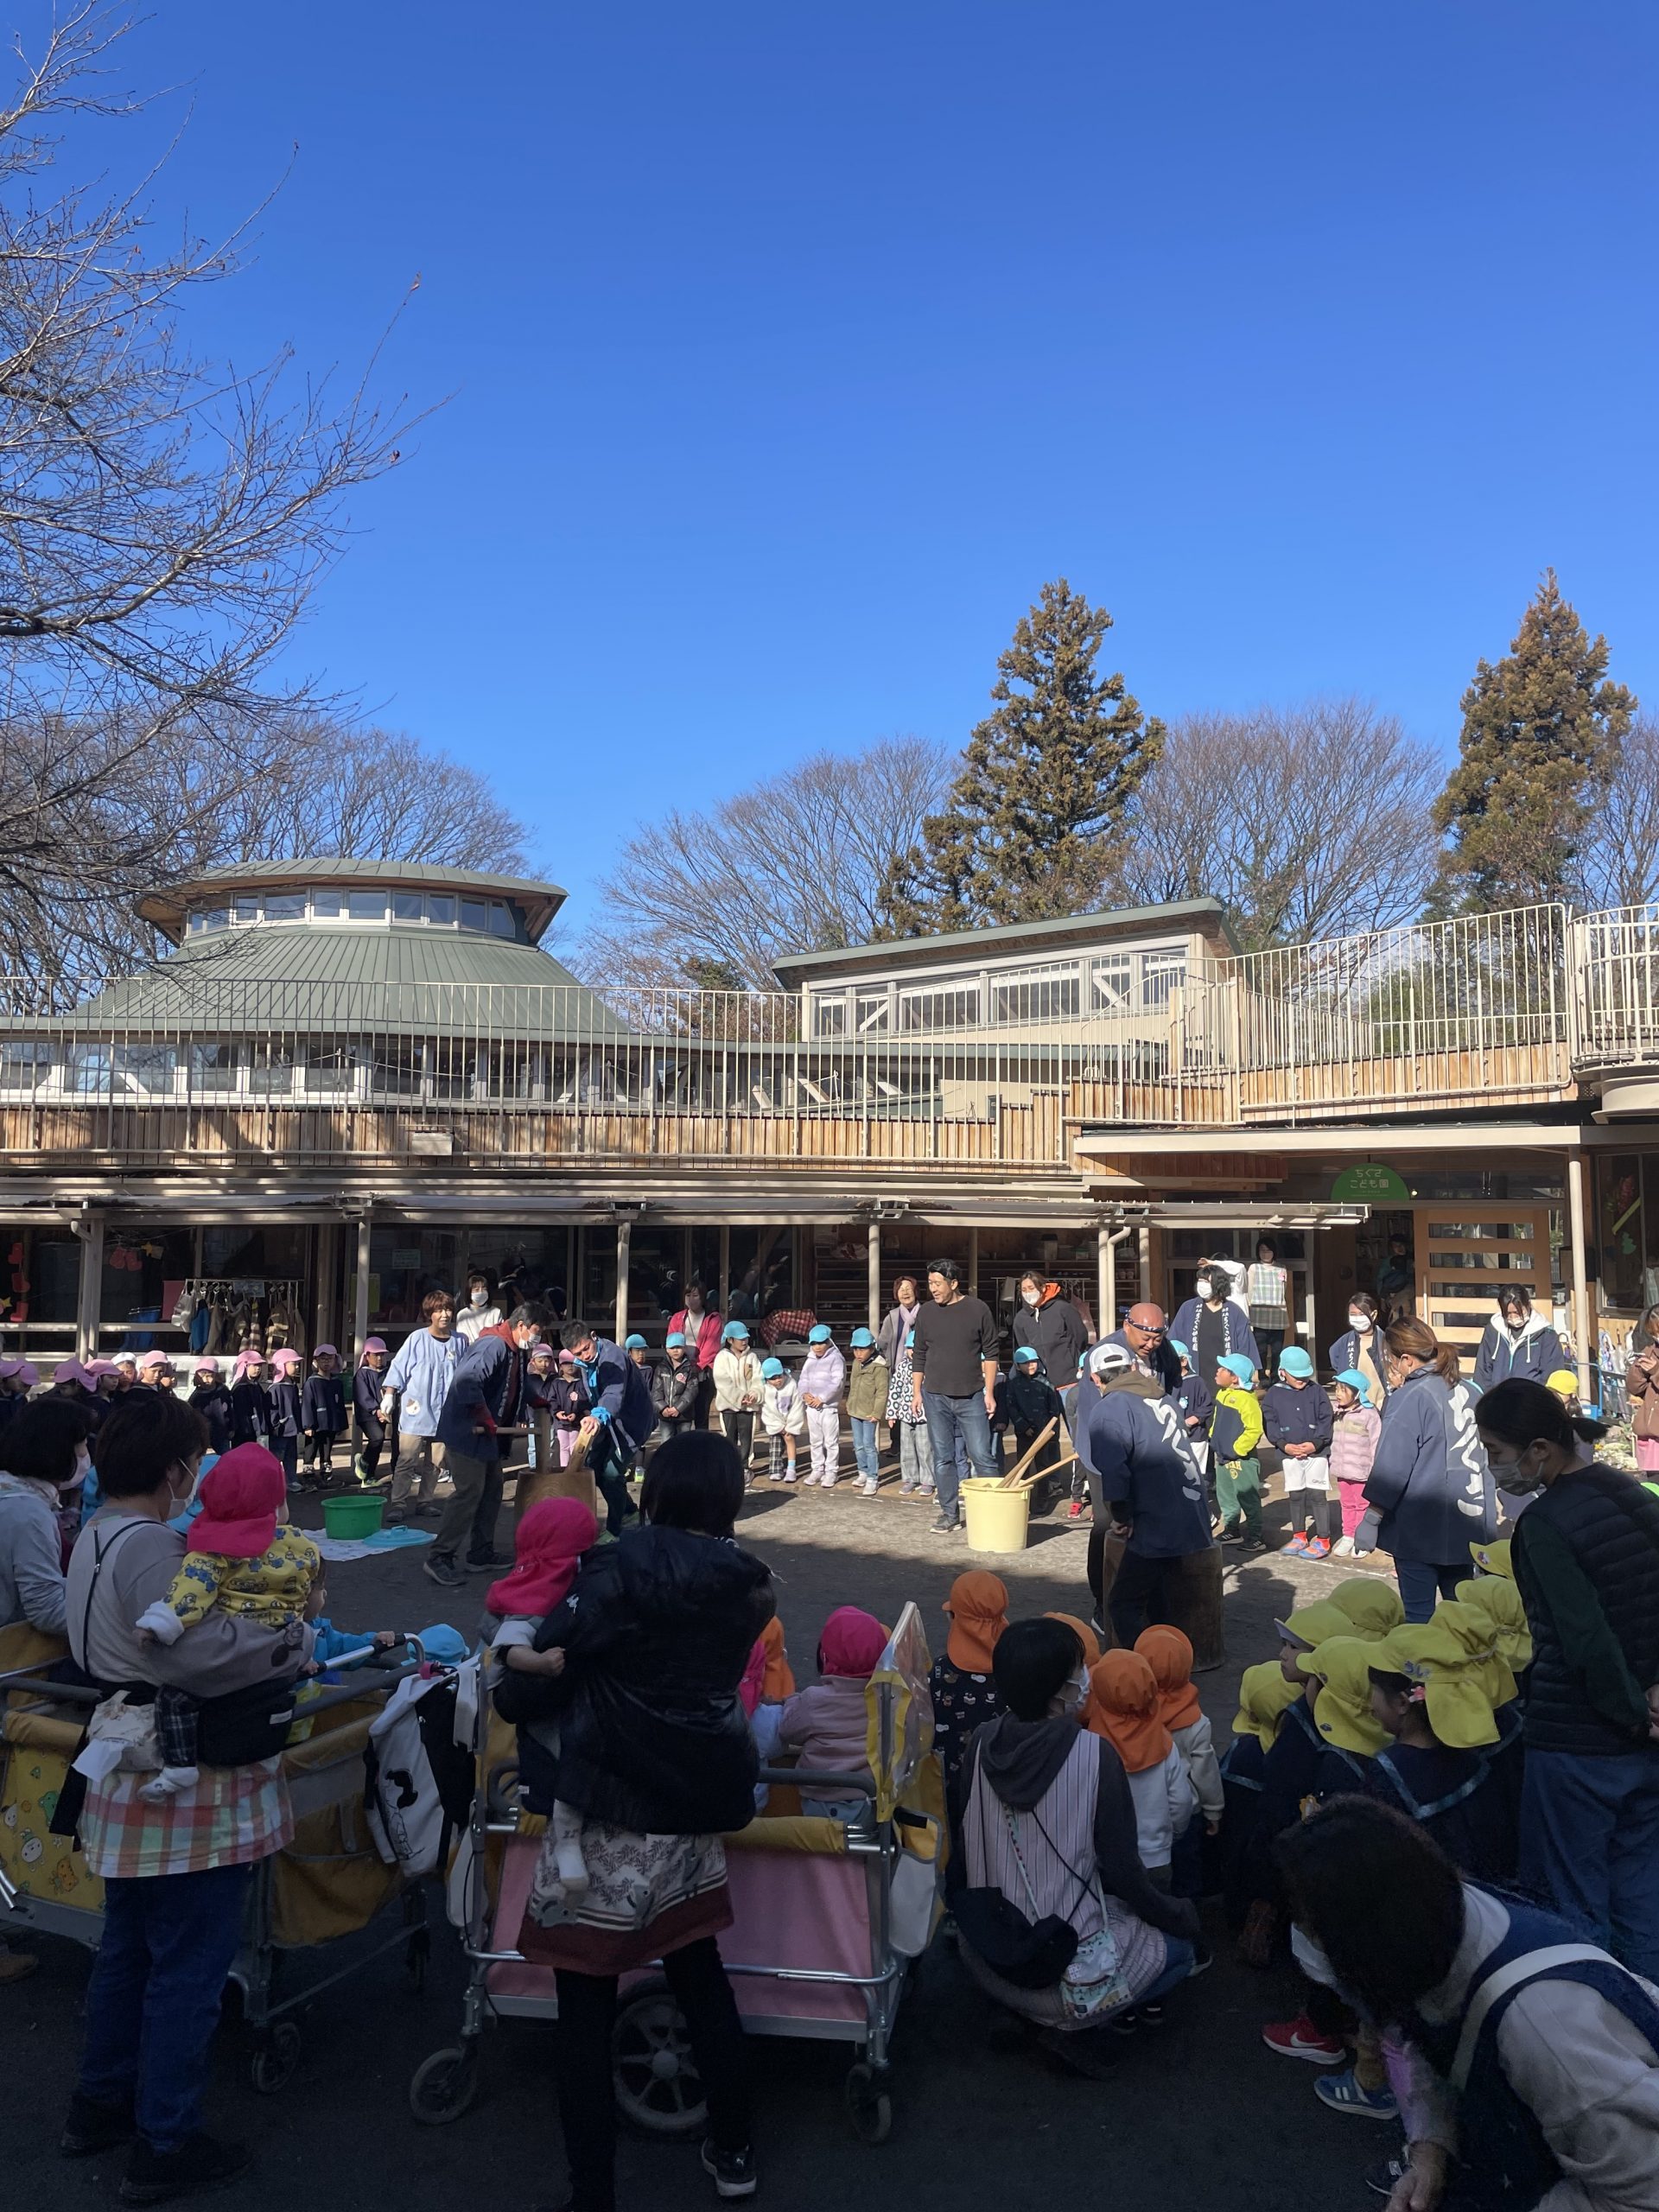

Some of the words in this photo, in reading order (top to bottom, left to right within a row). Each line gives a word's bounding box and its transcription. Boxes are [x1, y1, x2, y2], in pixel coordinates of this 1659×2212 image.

[1355, 1168, 1383, 1178] ちぐさ
[1350, 1179, 1389, 1189] こども園
